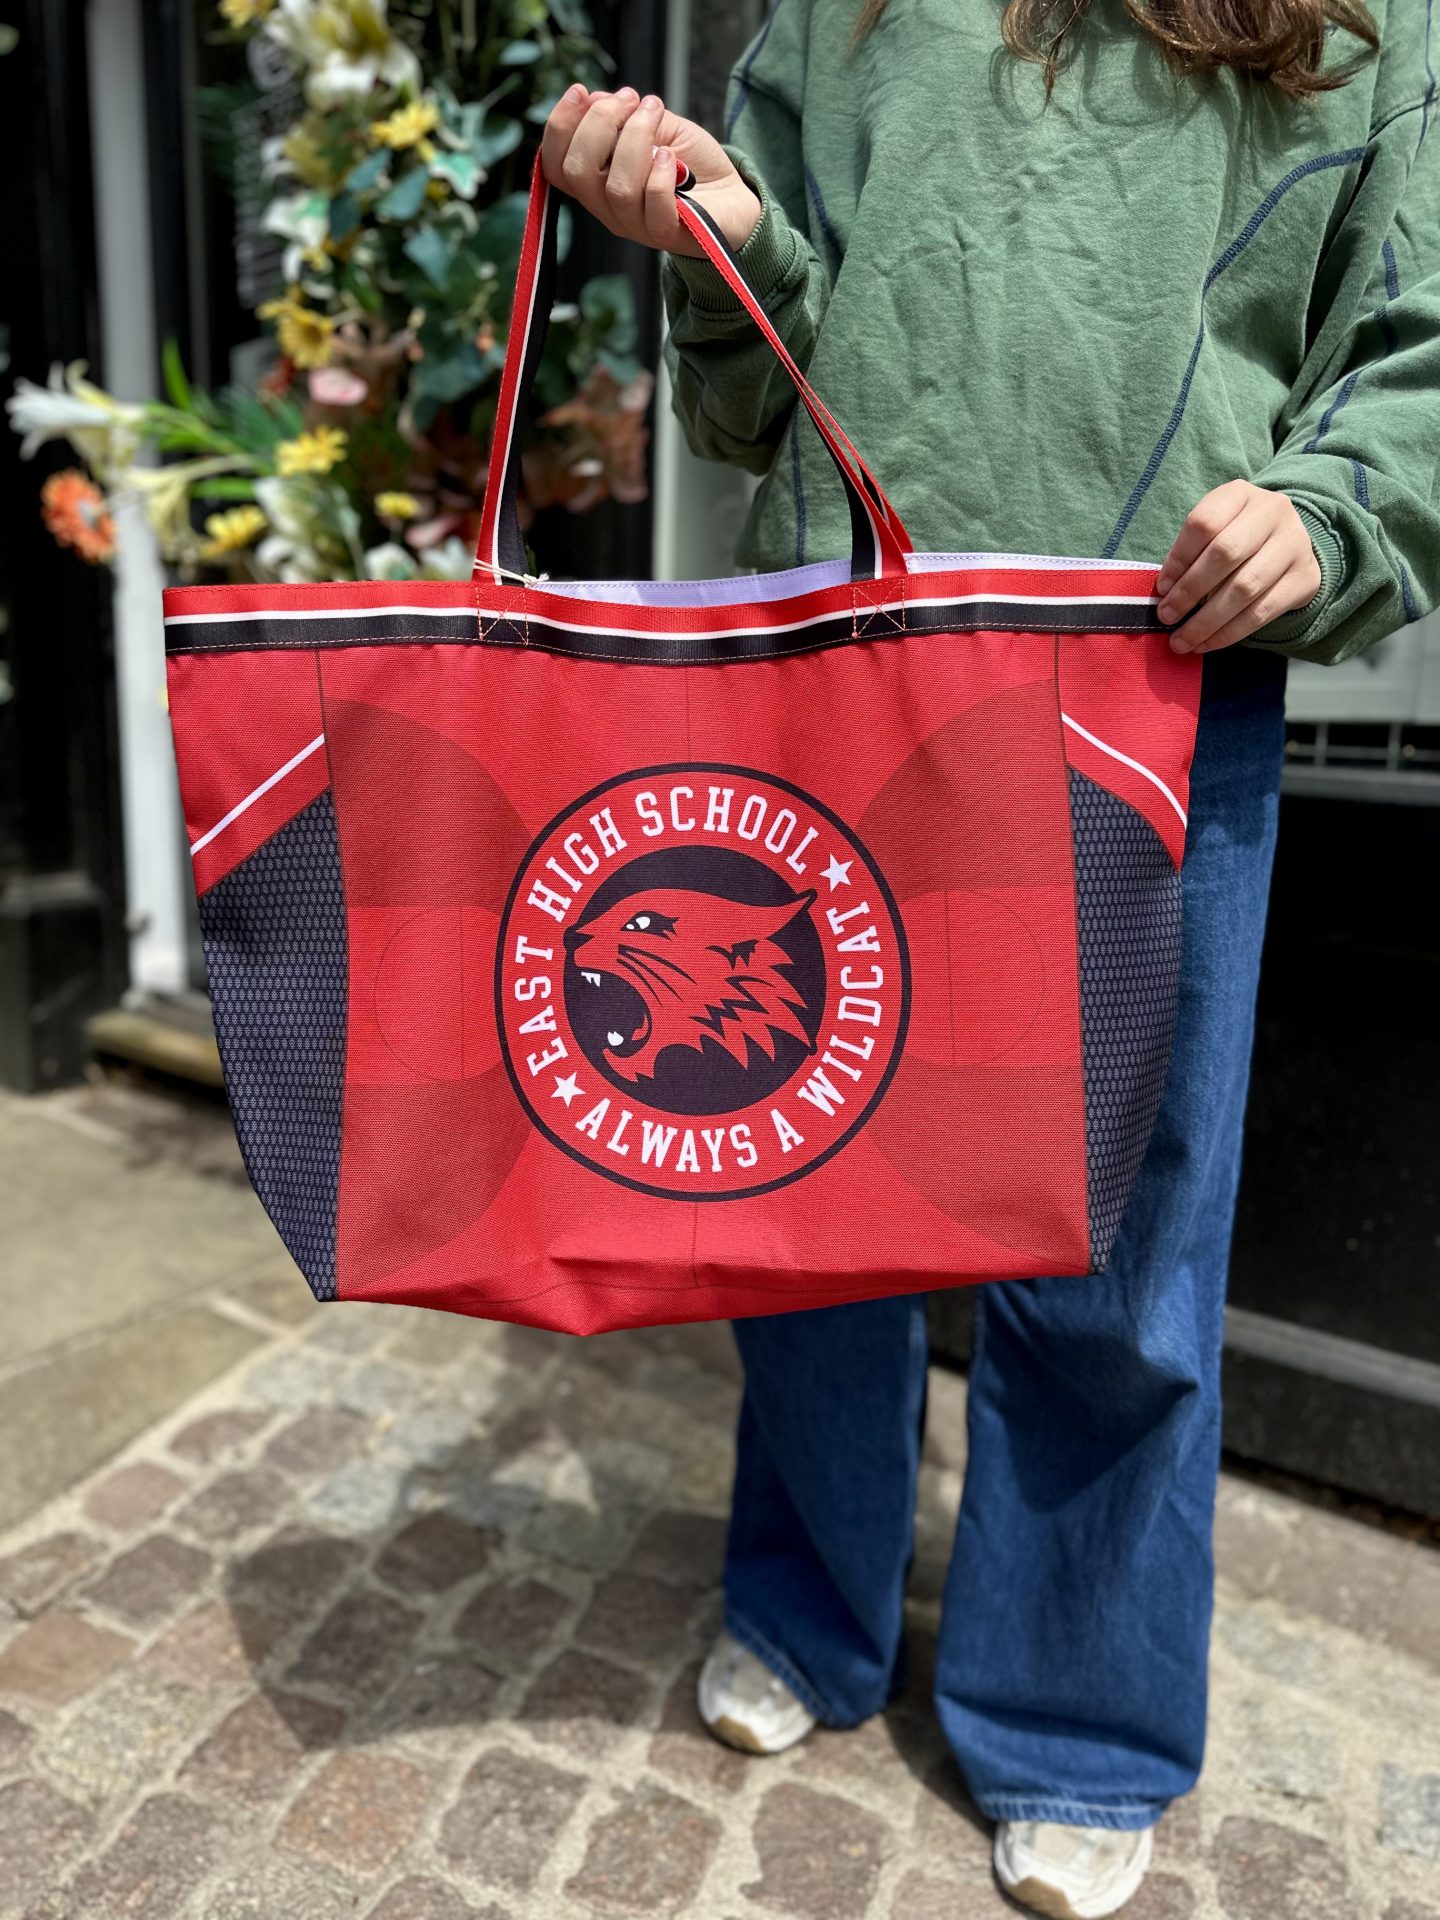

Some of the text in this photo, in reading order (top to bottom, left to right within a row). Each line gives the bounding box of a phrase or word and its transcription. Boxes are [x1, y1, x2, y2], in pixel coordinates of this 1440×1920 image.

[515, 786, 819, 1076] EAST HIGH SCHOOL
[575, 902, 883, 1172] ALWAYS A WILDCAT
